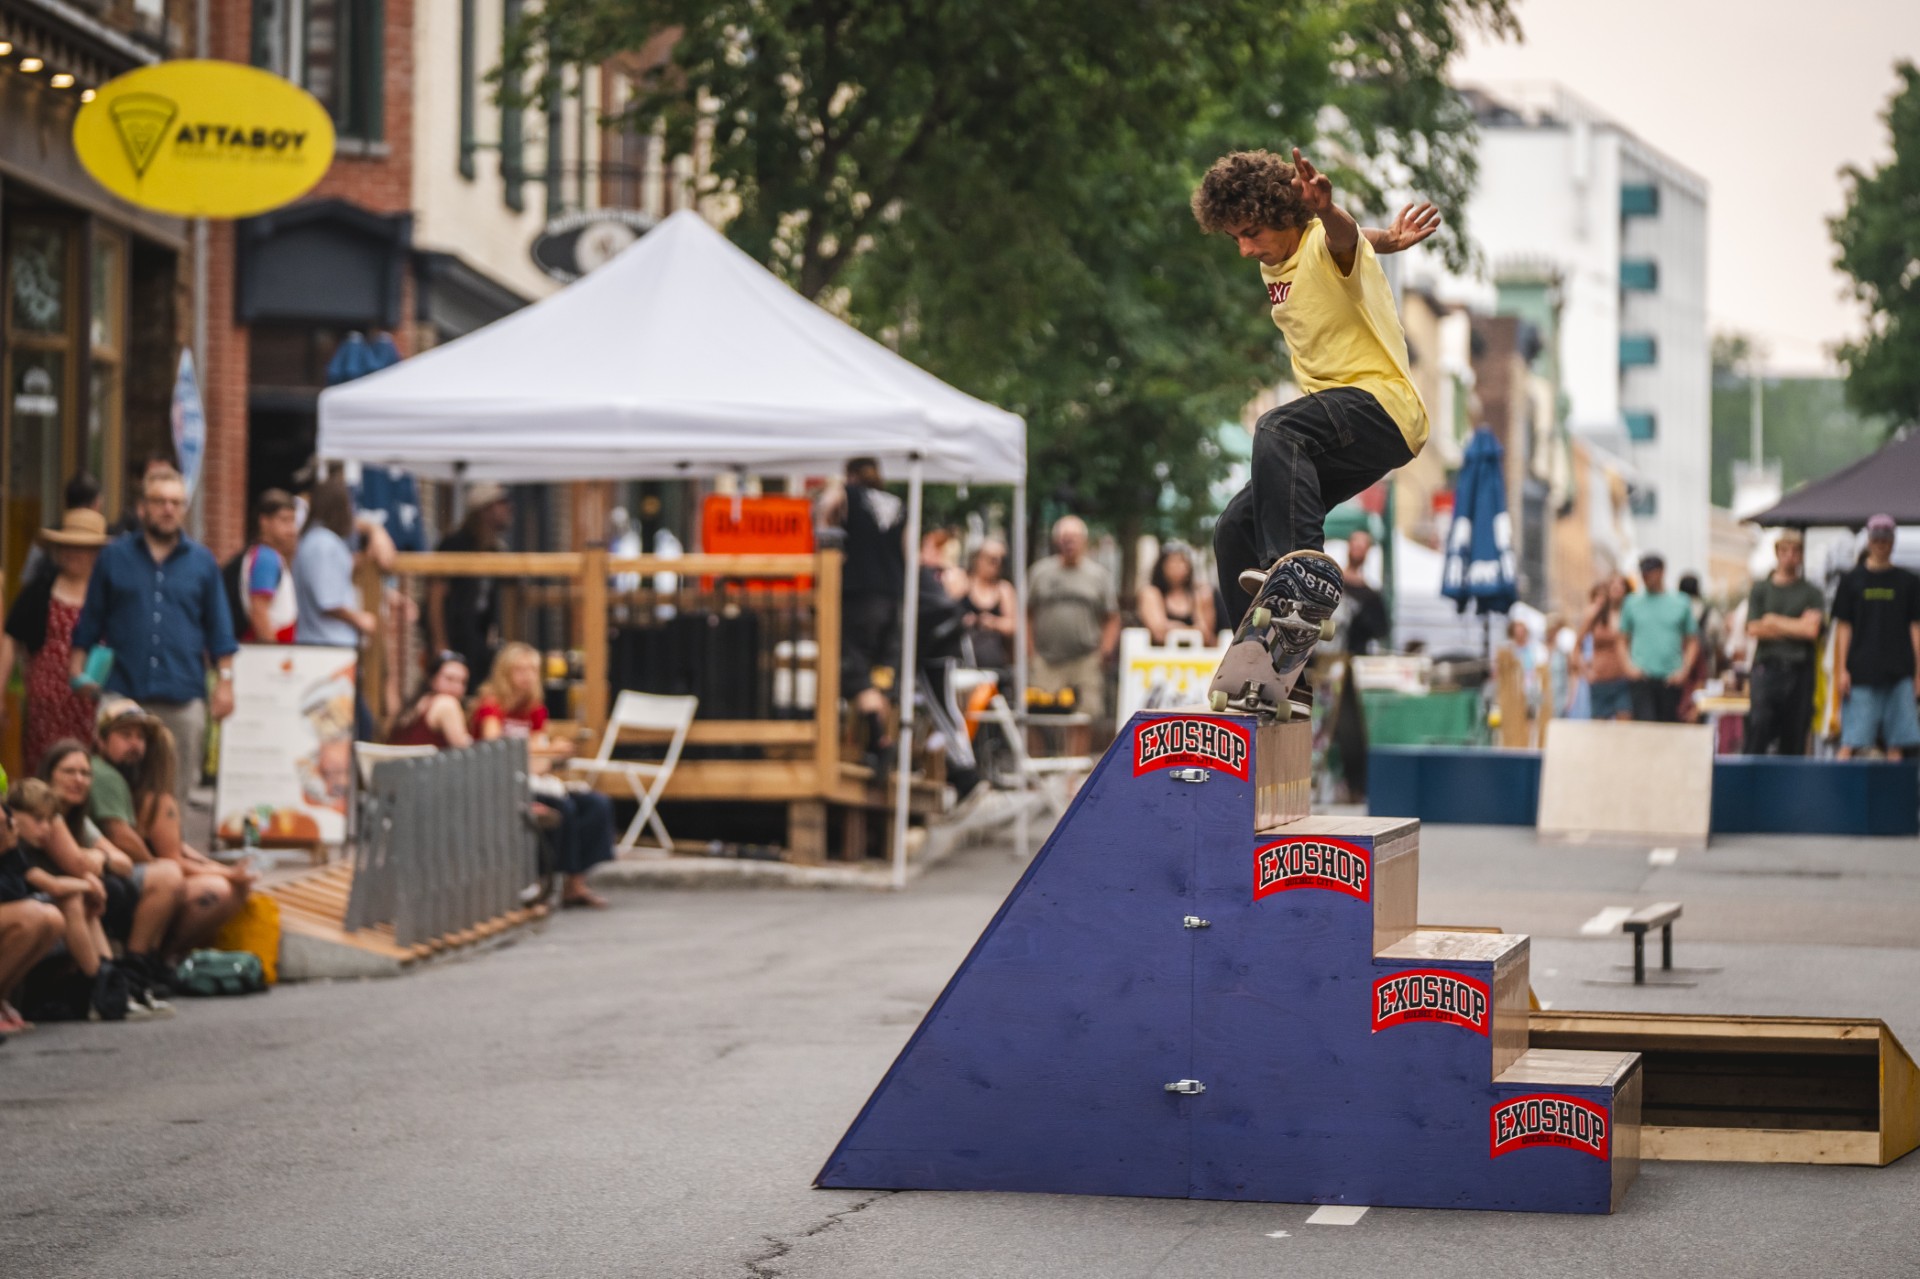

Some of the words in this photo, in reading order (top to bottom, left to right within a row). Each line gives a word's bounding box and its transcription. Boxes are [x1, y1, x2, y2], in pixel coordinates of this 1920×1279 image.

[176, 122, 307, 151] ATTABOY
[1139, 720, 1246, 771] EXOSHOP
[1258, 842, 1366, 892] EXOSHOP
[1377, 975, 1486, 1026] EXOSHOP
[1495, 1099, 1605, 1150] EXOSHOP
